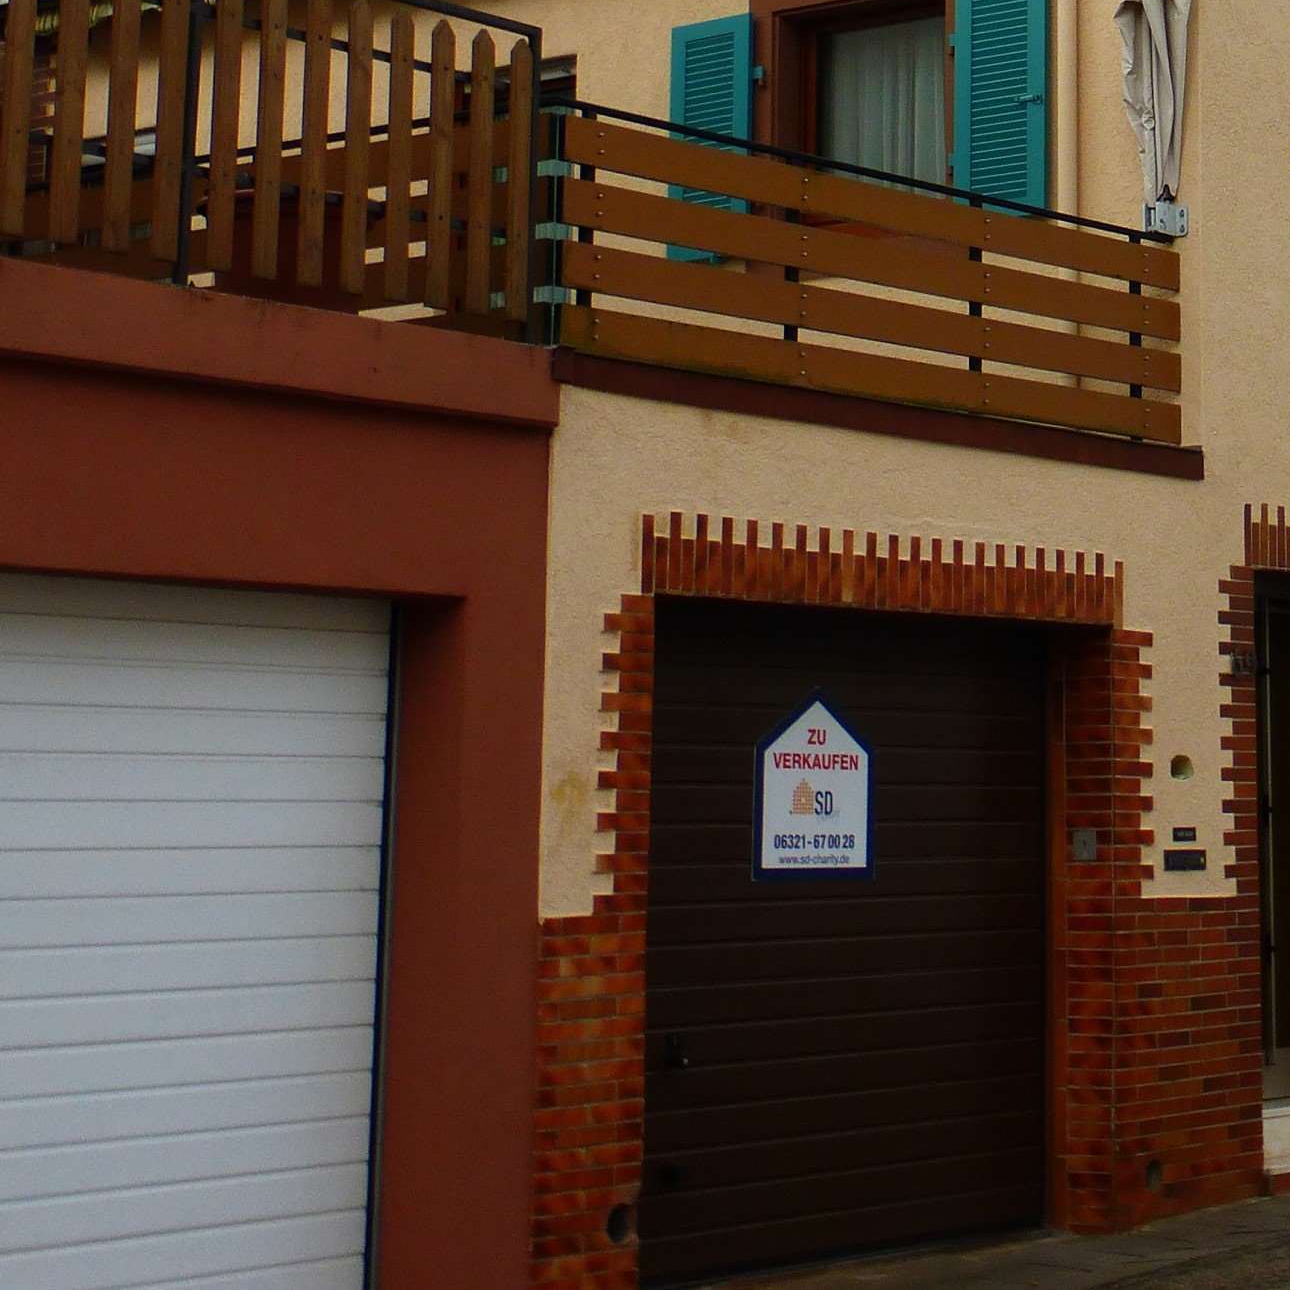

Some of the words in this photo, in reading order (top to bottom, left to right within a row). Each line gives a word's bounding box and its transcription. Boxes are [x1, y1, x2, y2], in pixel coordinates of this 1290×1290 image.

[807, 729, 827, 746] ZU
[773, 753, 859, 771] VERKAUFEN
[814, 790, 834, 816] SD
